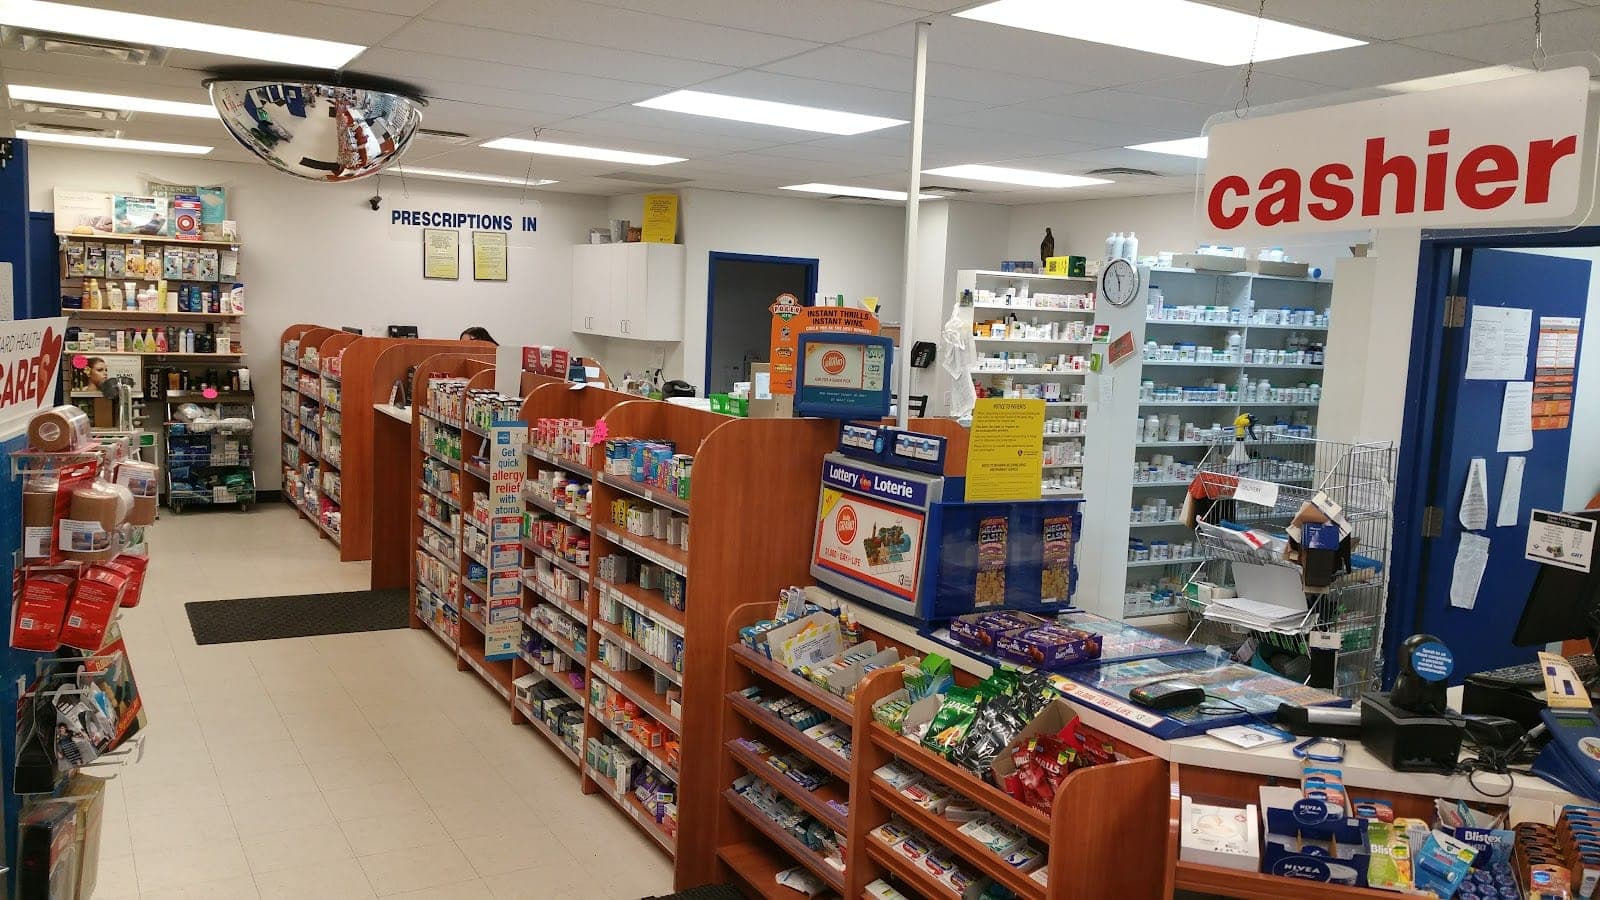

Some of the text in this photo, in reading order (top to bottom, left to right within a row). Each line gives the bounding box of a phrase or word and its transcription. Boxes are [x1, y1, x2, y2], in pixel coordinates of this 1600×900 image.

[1207, 128, 1578, 230] cashier
[391, 210, 537, 231] PRESCRIPTIONS IN
[807, 310, 837, 318] INSTANT
[150, 373, 159, 398] AXE
[501, 448, 516, 457] Get
[498, 459, 519, 469] quick
[492, 470, 525, 483] allergy
[829, 465, 913, 498] Lottery Loterie
[496, 483, 521, 494] relief
[499, 495, 516, 504] with
[495, 506, 520, 515] atoma
[1035, 756, 1060, 774] HALLS
[1465, 830, 1502, 845] Blistex
[1371, 843, 1393, 855] Blist
[1284, 864, 1321, 874] NIVEA
